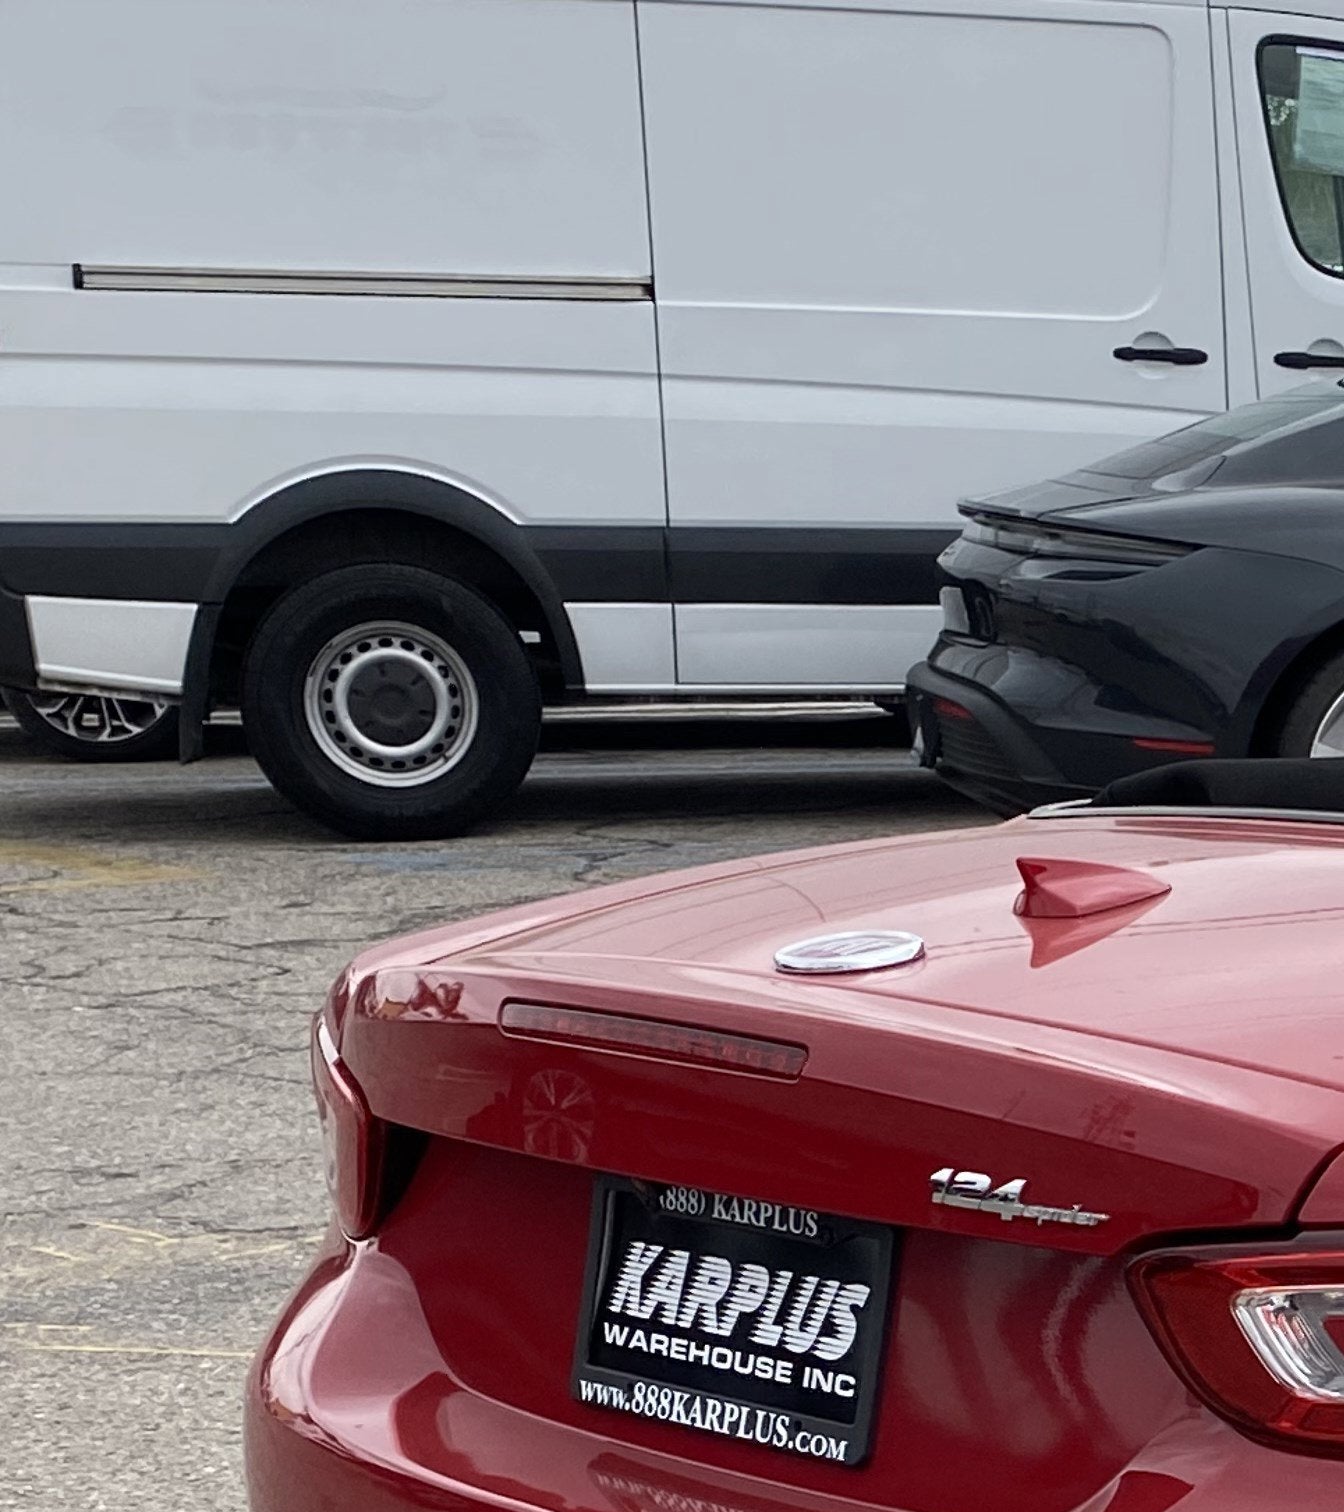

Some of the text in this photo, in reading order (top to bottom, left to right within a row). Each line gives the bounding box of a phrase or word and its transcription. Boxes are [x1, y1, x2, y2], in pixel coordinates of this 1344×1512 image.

[659, 1185, 819, 1238] (888) KARPLUS
[930, 1167, 1027, 1221] 124
[607, 1240, 871, 1362] KARPLUS
[602, 1321, 857, 1398] WAREHOUSE INC
